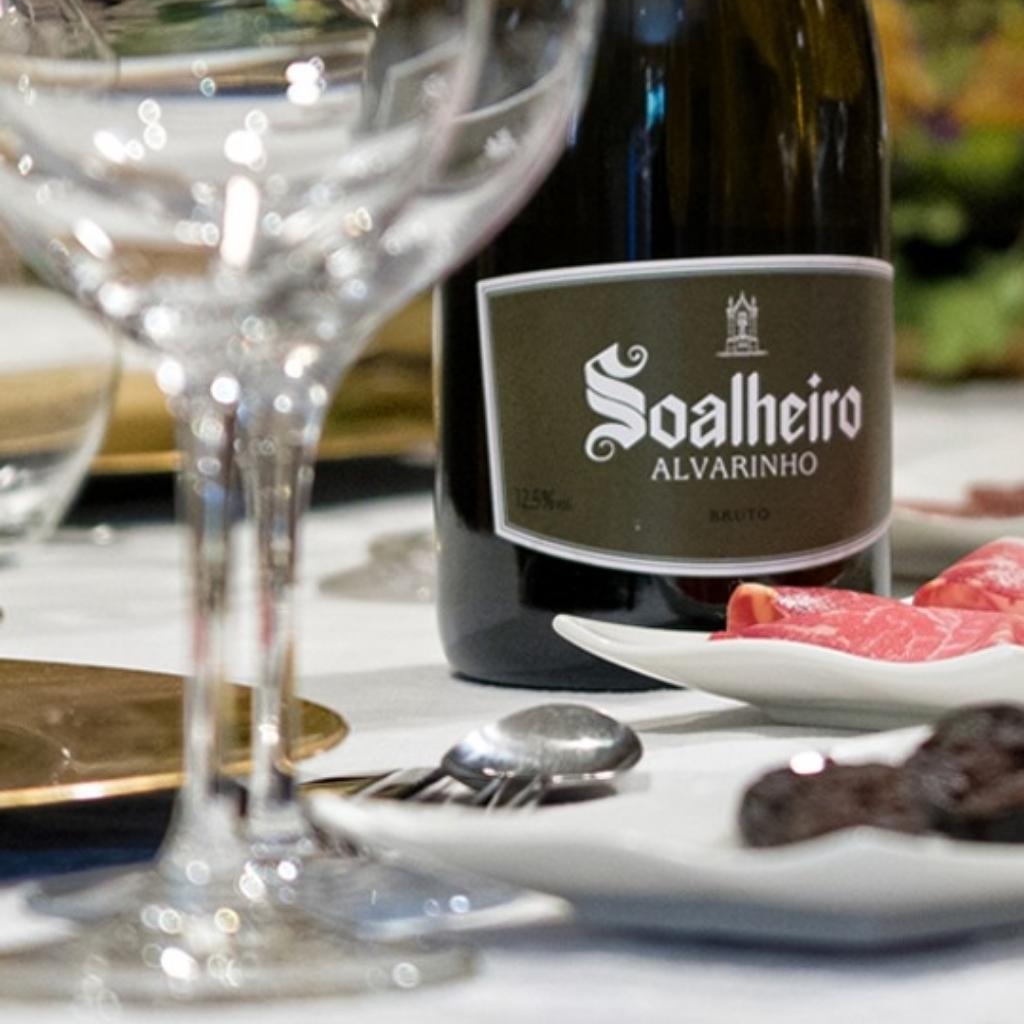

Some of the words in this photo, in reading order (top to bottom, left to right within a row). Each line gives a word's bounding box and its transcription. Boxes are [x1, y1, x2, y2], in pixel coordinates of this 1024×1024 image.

[584, 342, 863, 463] Soalheiro
[650, 451, 819, 481] ALVARINHO
[708, 506, 772, 524] BRUTO
